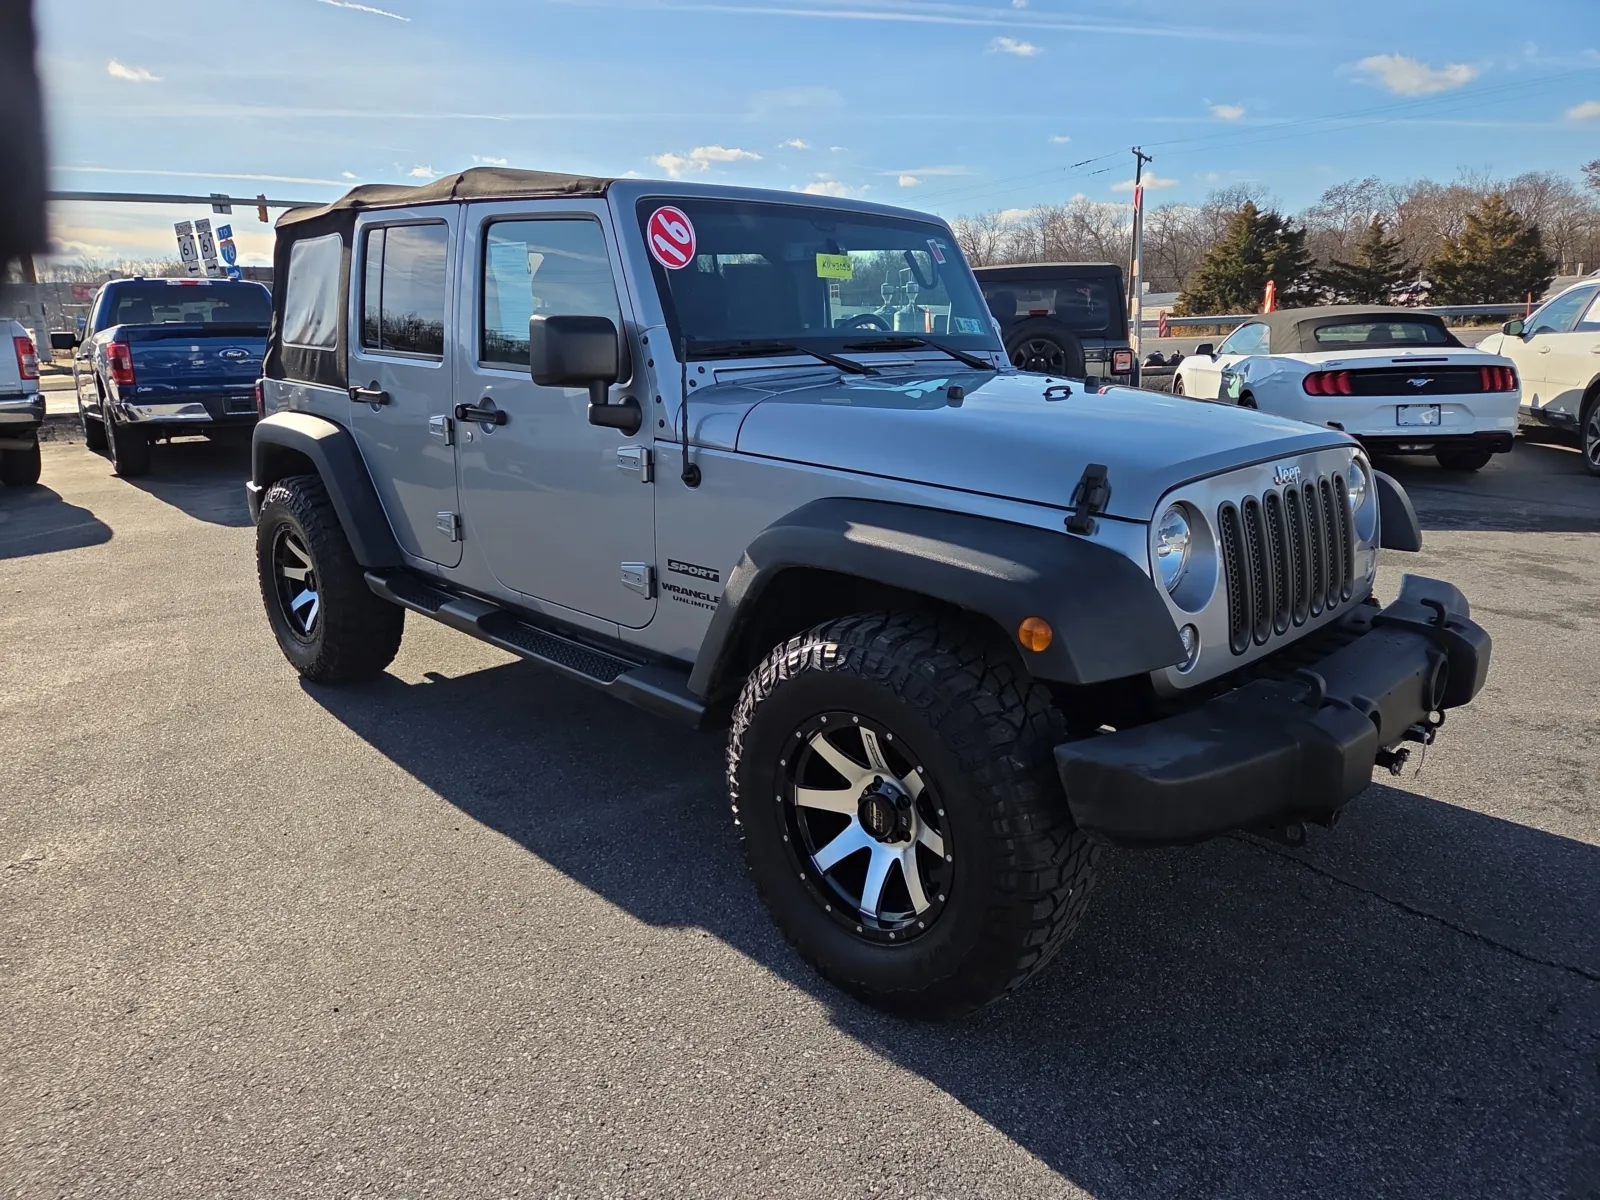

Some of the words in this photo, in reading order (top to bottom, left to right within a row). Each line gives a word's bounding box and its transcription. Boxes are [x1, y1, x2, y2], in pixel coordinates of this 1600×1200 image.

[219, 227, 228, 237] TO
[653, 213, 691, 263] 16
[182, 241, 195, 256] 61
[202, 238, 213, 253] 61
[222, 245, 235, 261] 78
[1273, 465, 1301, 486] Jeep
[669, 561, 717, 579] SPORT
[661, 581, 721, 604] WRANGLE
[672, 595, 717, 612] UNLIMITE
